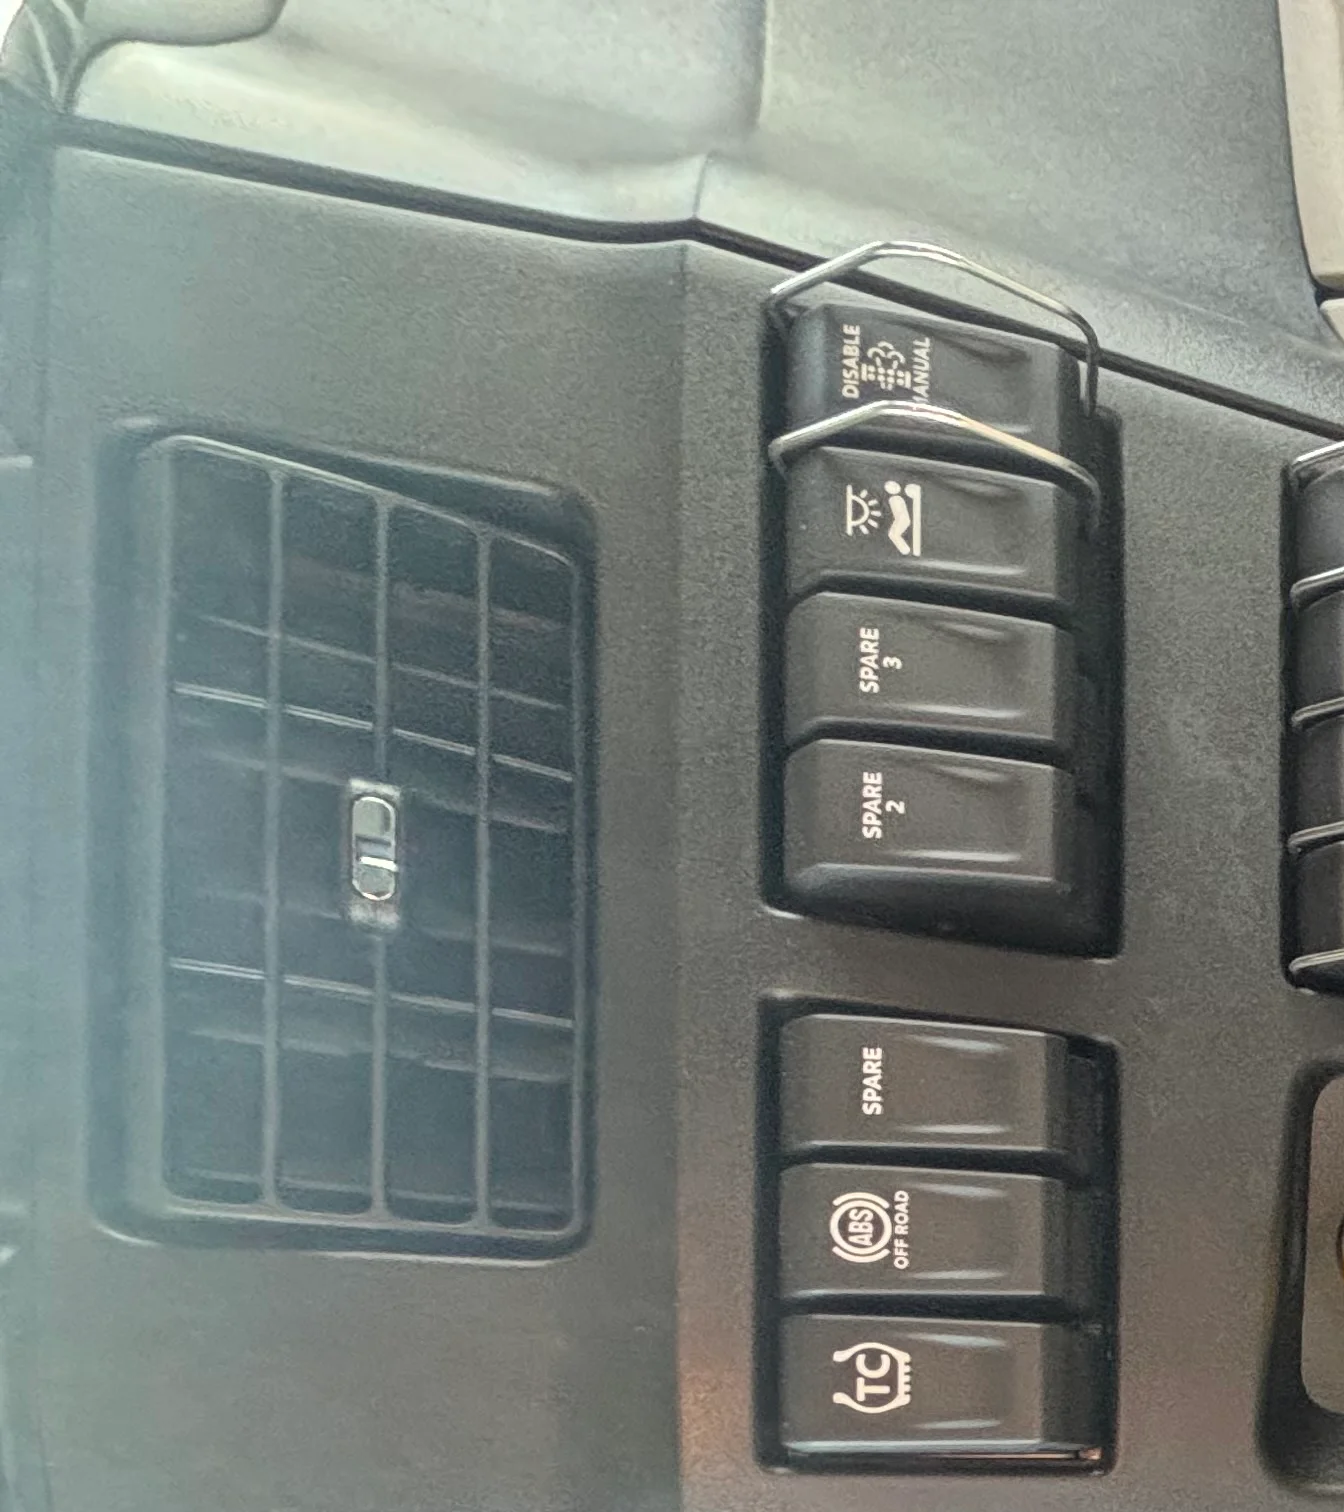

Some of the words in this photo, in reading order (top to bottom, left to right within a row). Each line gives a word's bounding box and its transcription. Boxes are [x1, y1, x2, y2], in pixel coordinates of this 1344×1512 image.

[841, 324, 860, 399] DISABLE
[859, 627, 881, 693] SPARE
[882, 656, 902, 669] 3
[862, 772, 883, 839] SPARE
[886, 801, 905, 814] 2
[862, 1047, 883, 1116] SPARE
[848, 1208, 875, 1246] ABS
[893, 1191, 910, 1235] ROAD
[894, 1238, 910, 1269] OFF
[856, 1353, 891, 1401] TC
